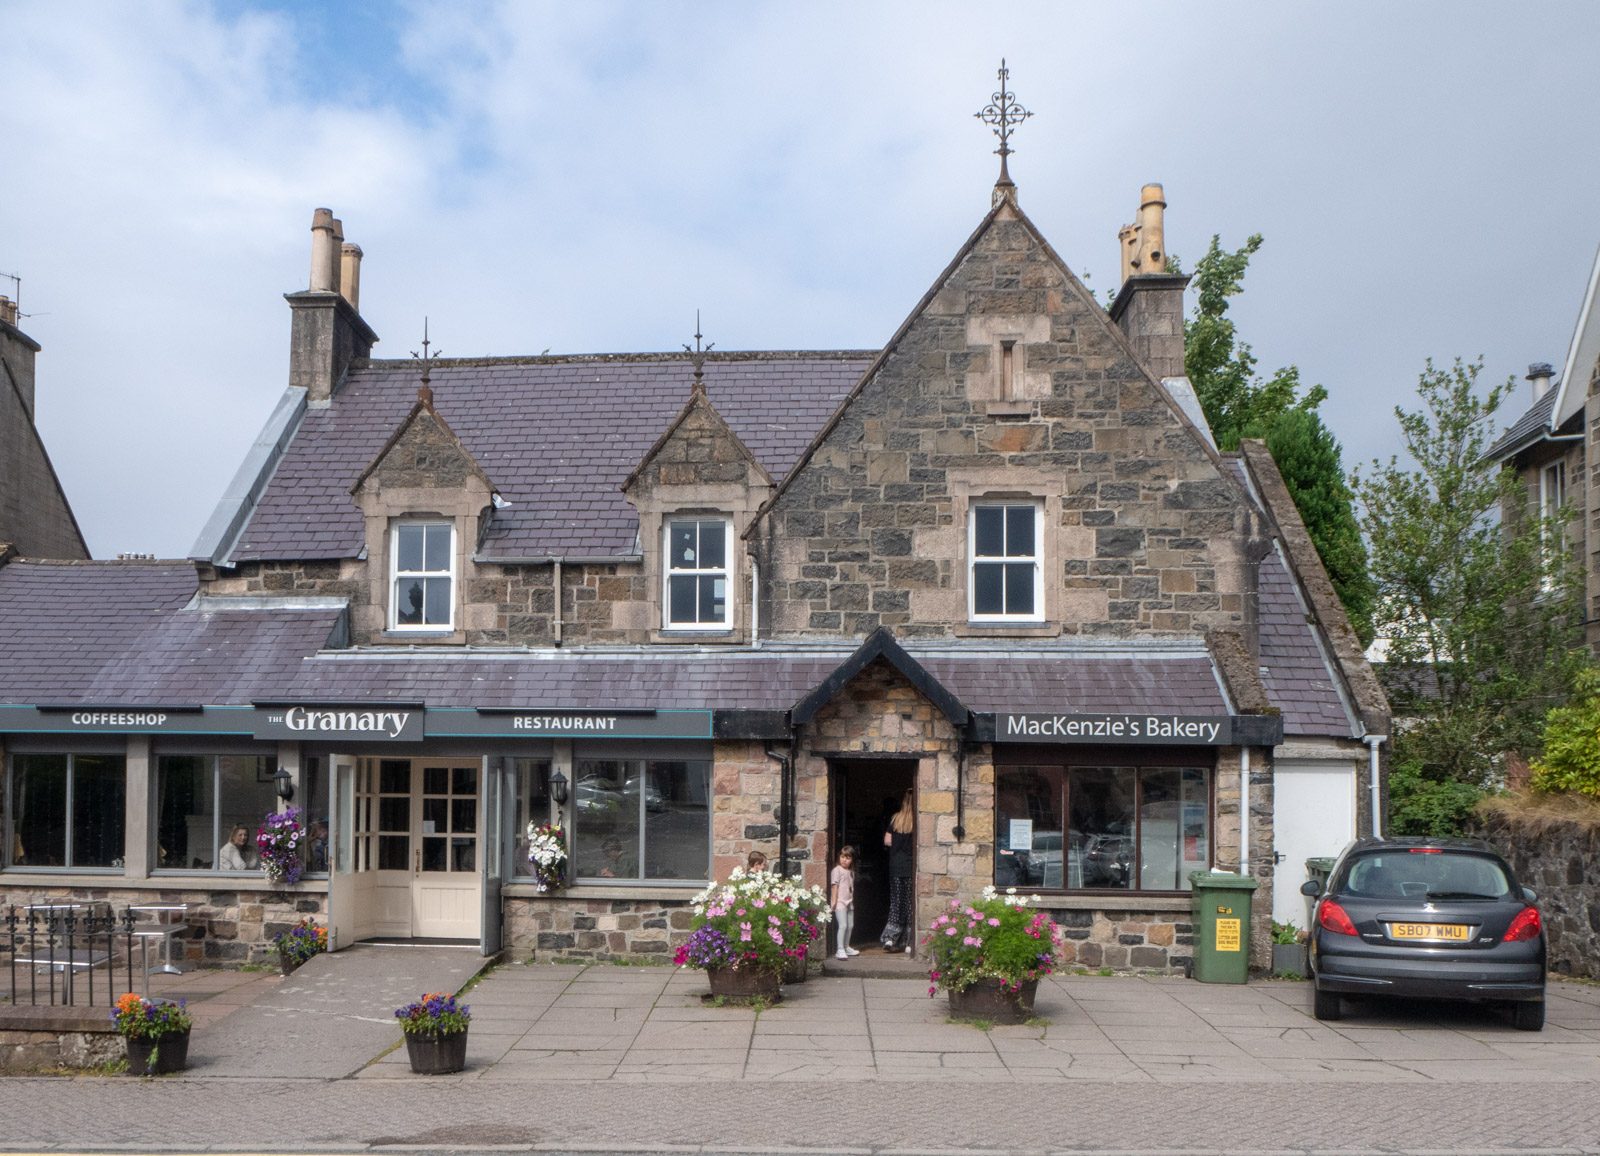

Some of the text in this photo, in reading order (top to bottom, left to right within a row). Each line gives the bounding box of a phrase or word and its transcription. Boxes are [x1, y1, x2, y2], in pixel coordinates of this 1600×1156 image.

[71, 713, 167, 726] COFFEESHOP
[267, 707, 410, 738] THE Granary
[513, 716, 617, 729] RESTAURANT
[1007, 715, 1221, 742] MacKenzie's Bakery
[1398, 925, 1462, 938] SB07 WMU
